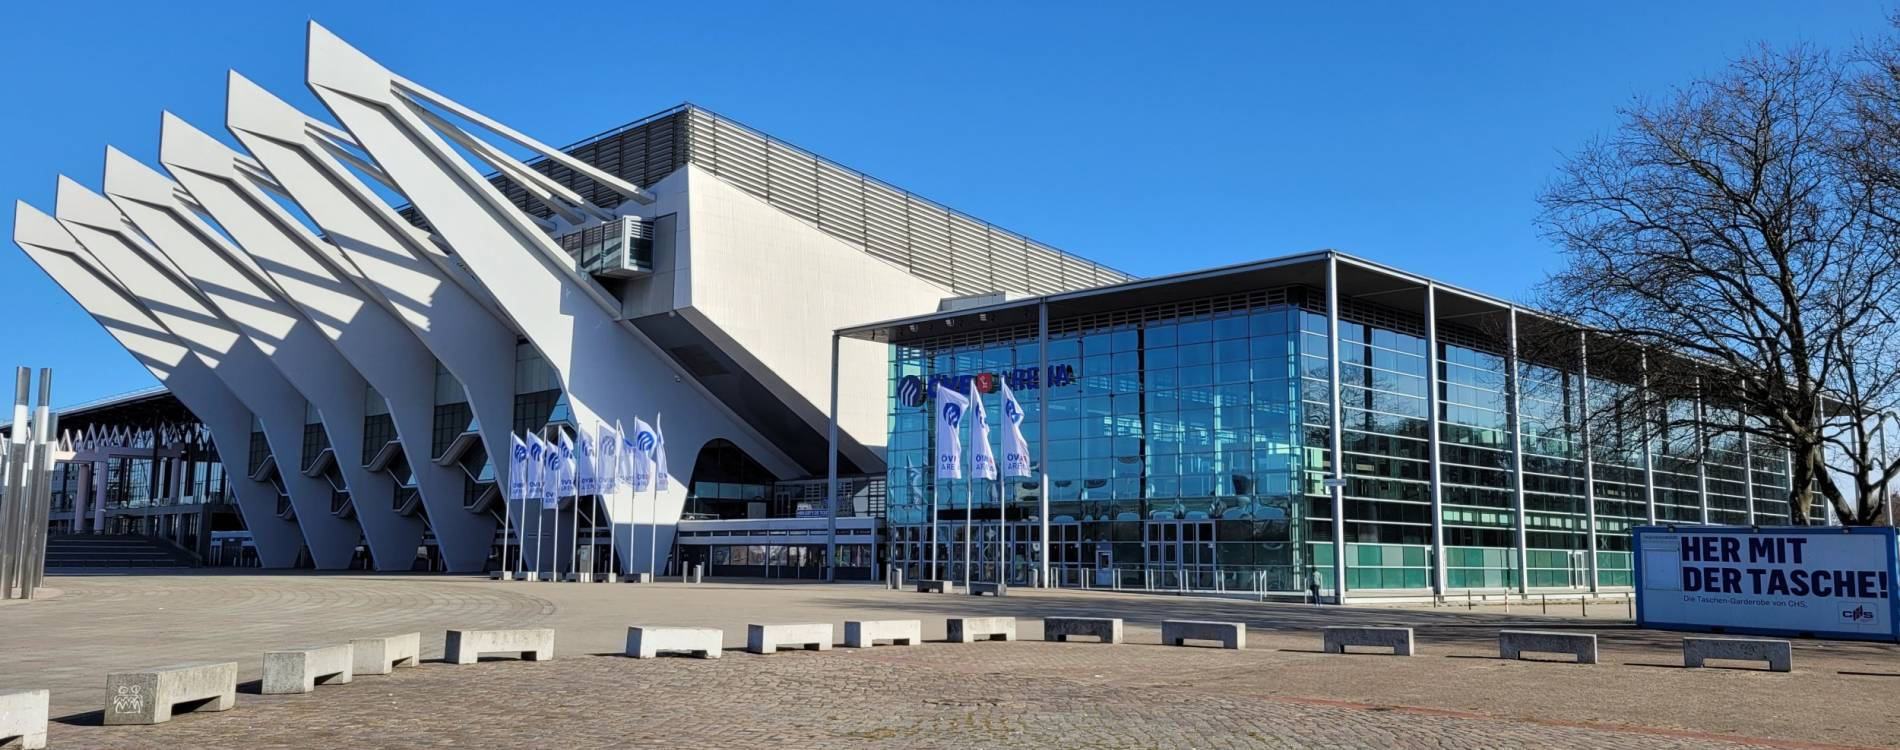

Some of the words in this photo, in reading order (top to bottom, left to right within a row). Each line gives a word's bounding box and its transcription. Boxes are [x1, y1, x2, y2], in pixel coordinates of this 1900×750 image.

[1681, 536, 1741, 562] HER
[1748, 537, 1807, 564] MIT
[1682, 566, 1742, 594] DER
[1747, 568, 1889, 599] TASCHE!
[1696, 596, 1770, 606] Taschen-Garderobe
